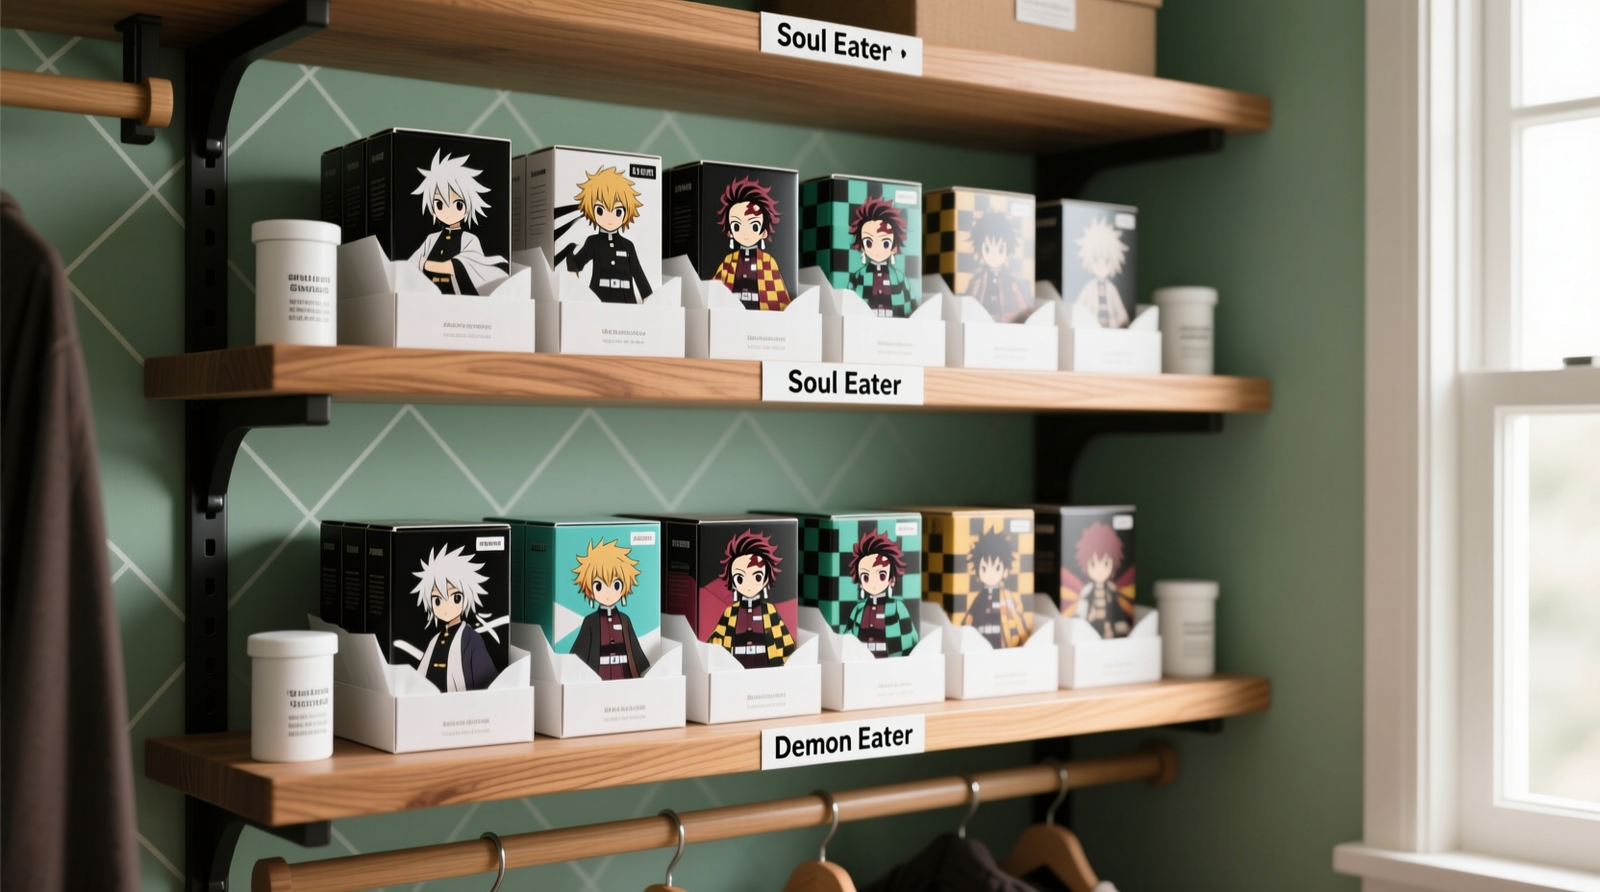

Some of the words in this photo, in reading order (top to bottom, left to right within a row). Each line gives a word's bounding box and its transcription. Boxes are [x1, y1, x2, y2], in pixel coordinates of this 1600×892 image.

[777, 22, 827, 53] Soul
[834, 31, 892, 62] Eater
[788, 369, 838, 394] Soul
[845, 371, 902, 396] Eater
[775, 734, 852, 759] Demon
[858, 726, 913, 750] Eater
